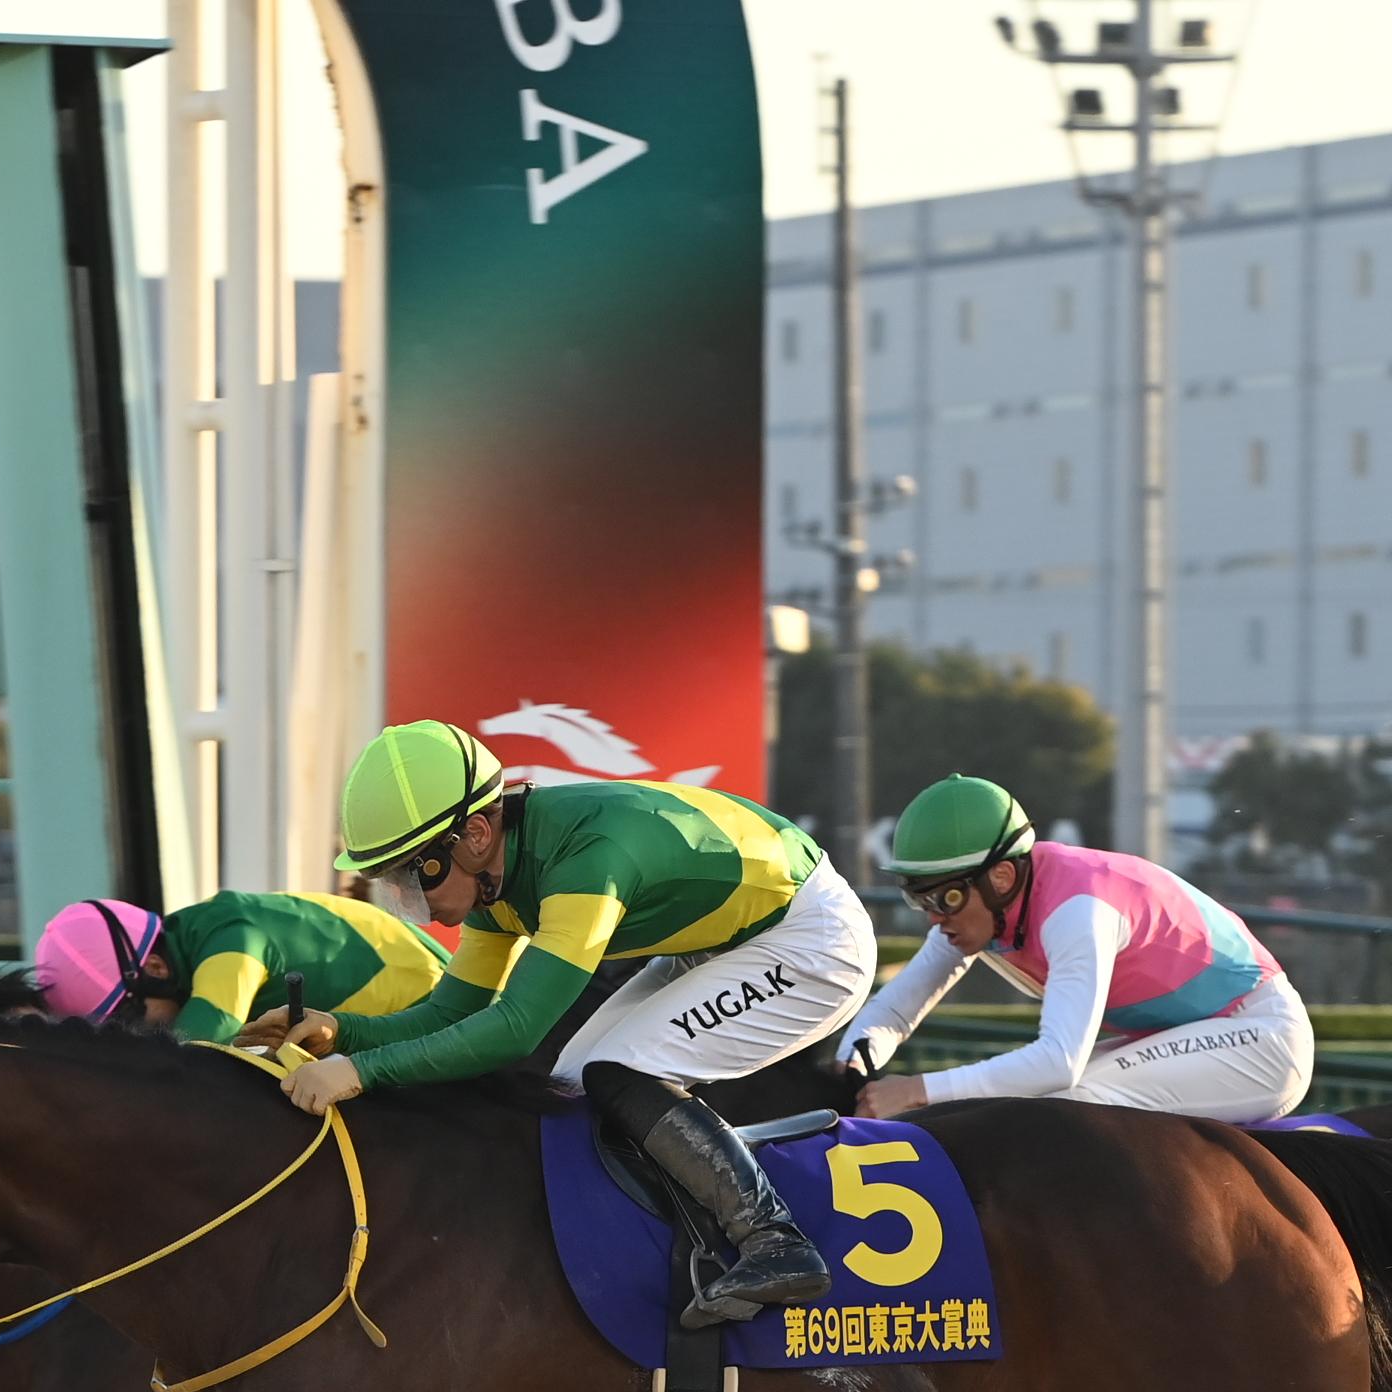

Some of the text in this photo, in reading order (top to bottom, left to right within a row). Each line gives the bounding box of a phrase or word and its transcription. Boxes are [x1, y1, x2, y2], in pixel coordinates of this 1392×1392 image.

[669, 961, 797, 1041] YUGA.K
[1114, 1027, 1260, 1071] B. MURZABAYEV
[825, 1141, 943, 1287] 5
[783, 1298, 992, 1359] 第69回東京大賞典
